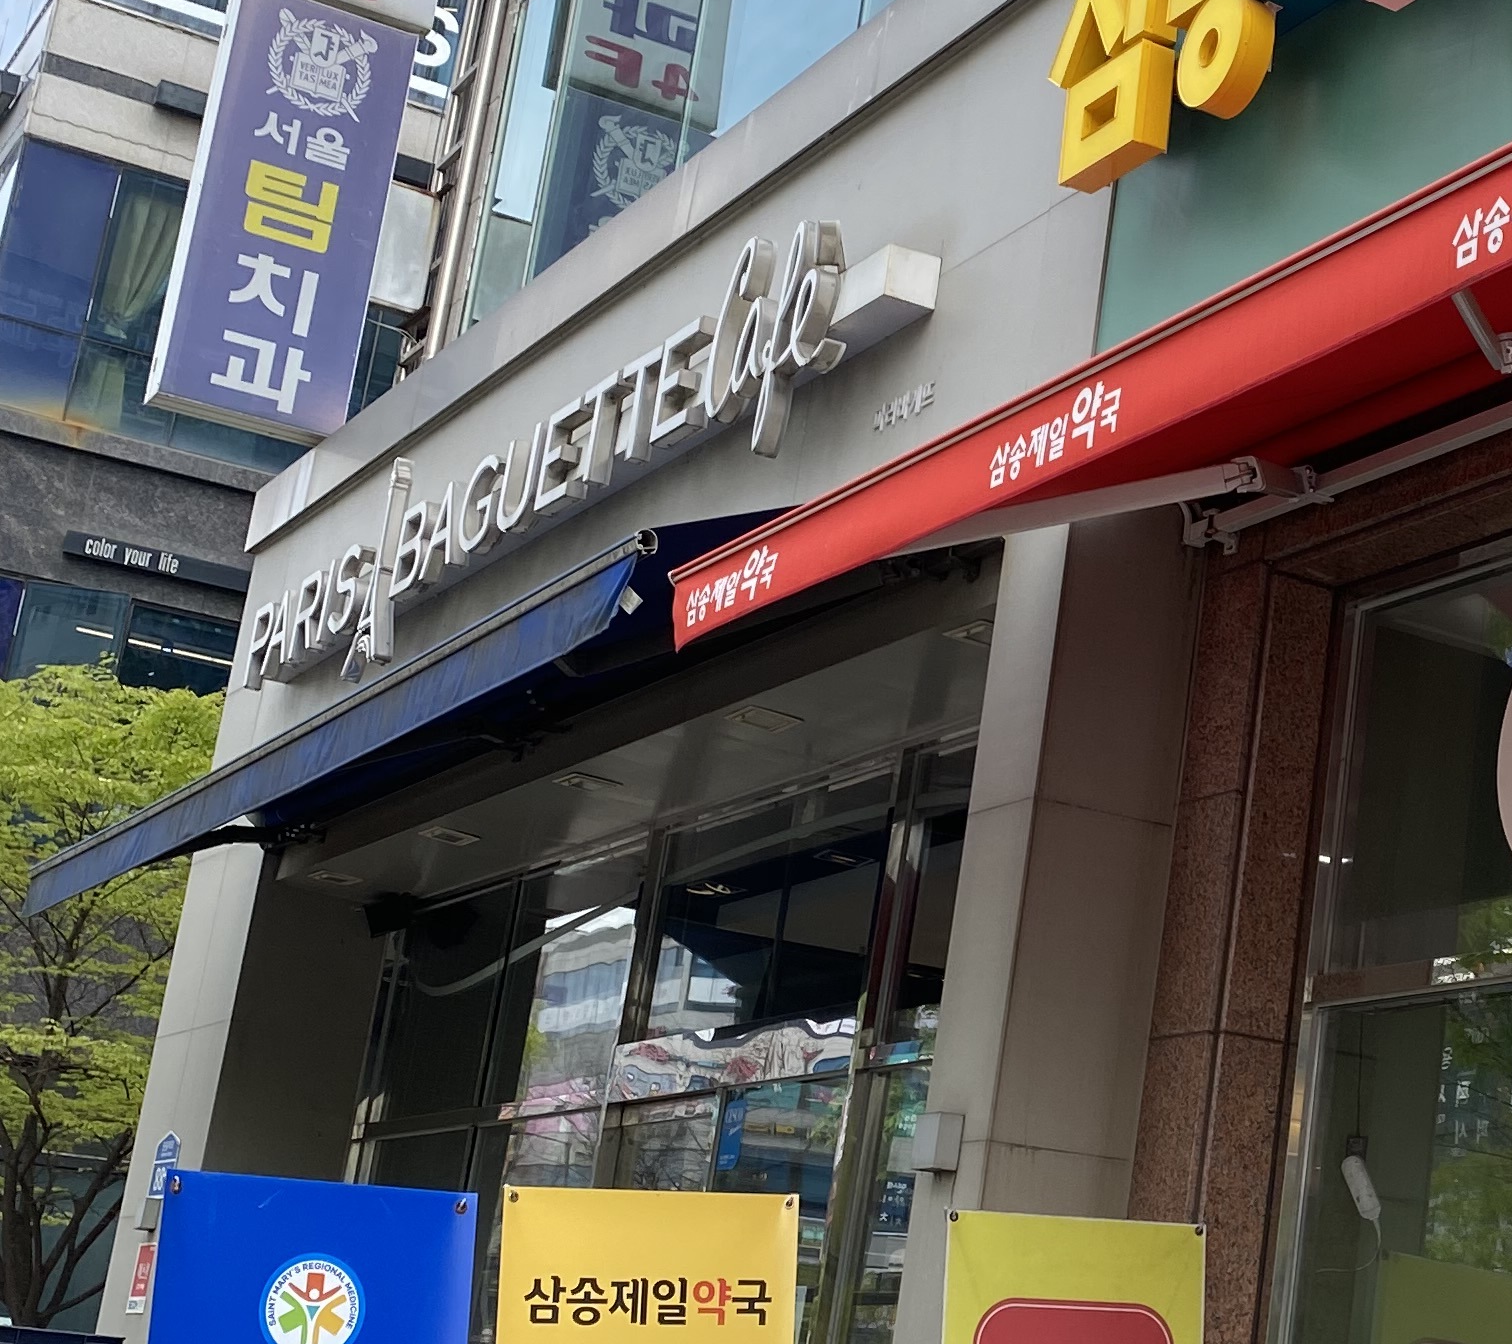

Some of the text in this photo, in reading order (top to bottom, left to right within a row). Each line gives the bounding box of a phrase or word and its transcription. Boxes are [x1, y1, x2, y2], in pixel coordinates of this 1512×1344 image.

[254, 108, 351, 171] 서울
[988, 380, 1123, 490] 삼송제일약국
[245, 542, 373, 690] PARIS
[389, 317, 713, 602] BAGUETTE
[84, 537, 180, 575] color your life
[685, 544, 780, 629] 삼송제일약국
[267, 1262, 358, 1330] SAINT MARY'S REGIONAL MEDICINE
[523, 1274, 773, 1327] 삼송제일약국
